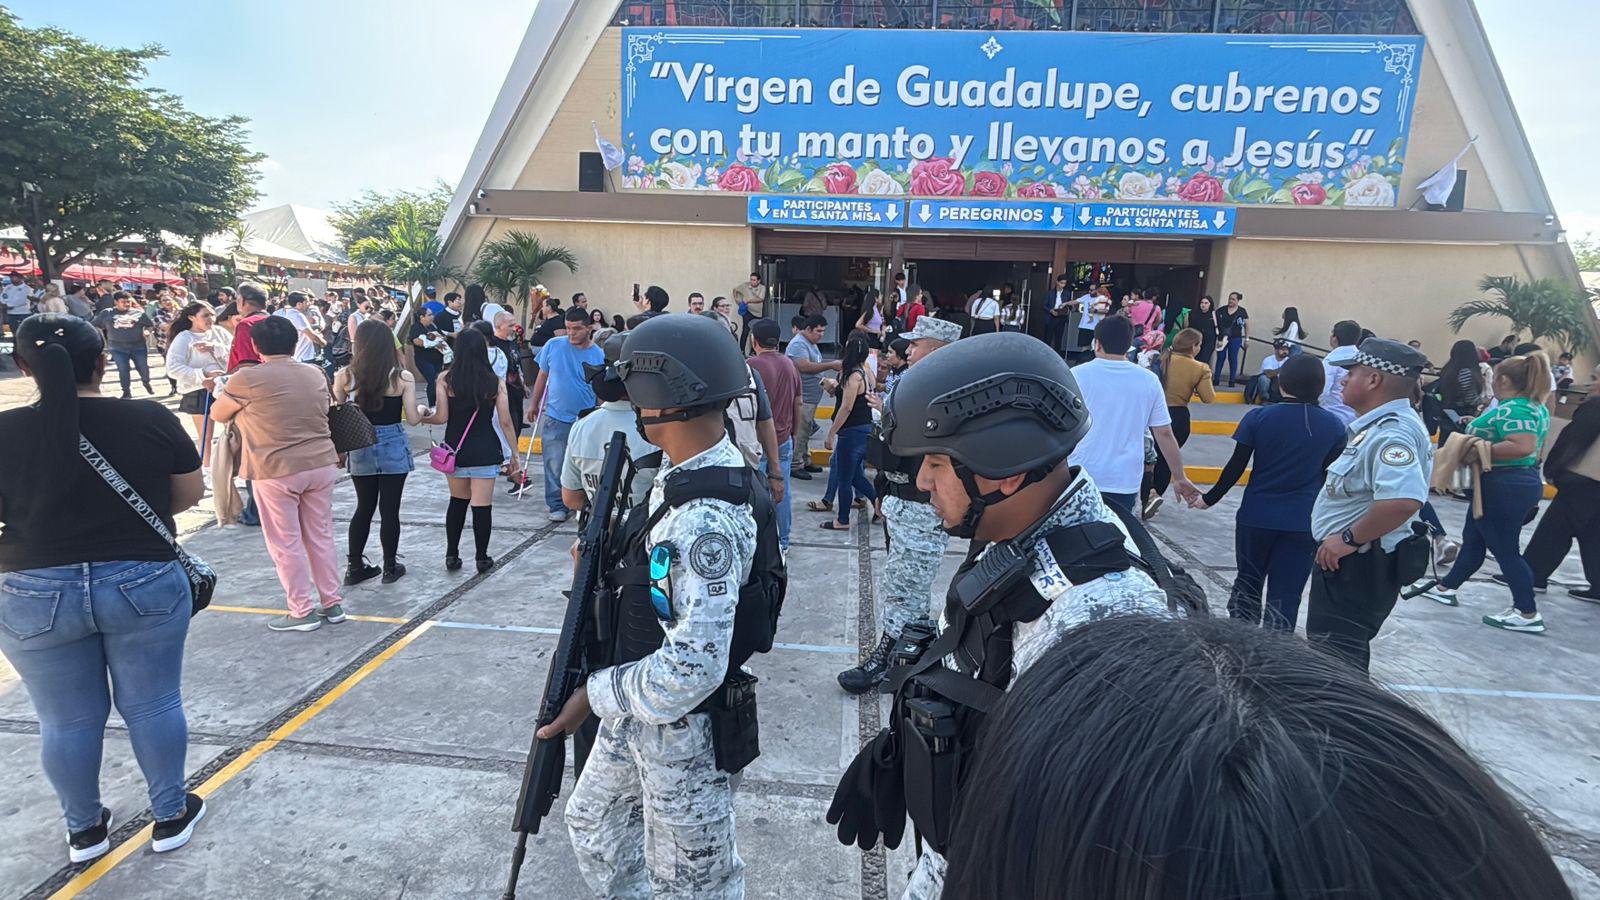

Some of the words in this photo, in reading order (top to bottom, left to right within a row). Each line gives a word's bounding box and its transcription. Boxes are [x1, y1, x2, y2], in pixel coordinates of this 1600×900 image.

[650, 62, 813, 113] "Virgen
[829, 65, 881, 105] de
[897, 65, 1152, 119] Guadalupe,
[1170, 71, 1382, 114] cubrenos
[650, 127, 724, 155] con
[739, 124, 781, 157] tu
[798, 126, 935, 159] manto
[949, 134, 974, 170] y
[987, 121, 1166, 164] llevanos
[1183, 138, 1209, 166] a
[1224, 127, 1375, 169] Jesús"
[783, 200, 872, 211] PARTICIPANTES
[772, 209, 787, 218] EN
[792, 210, 807, 219] LA
[811, 211, 849, 221] SANTA
[853, 211, 882, 222] MISA
[939, 206, 1044, 222] PEREGRINOS
[1106, 207, 1199, 219] PARTICIPANTES
[1094, 217, 1110, 226] EN
[1115, 218, 1131, 227] LA
[1135, 218, 1174, 228] SANTA
[1178, 219, 1209, 229] MISA
